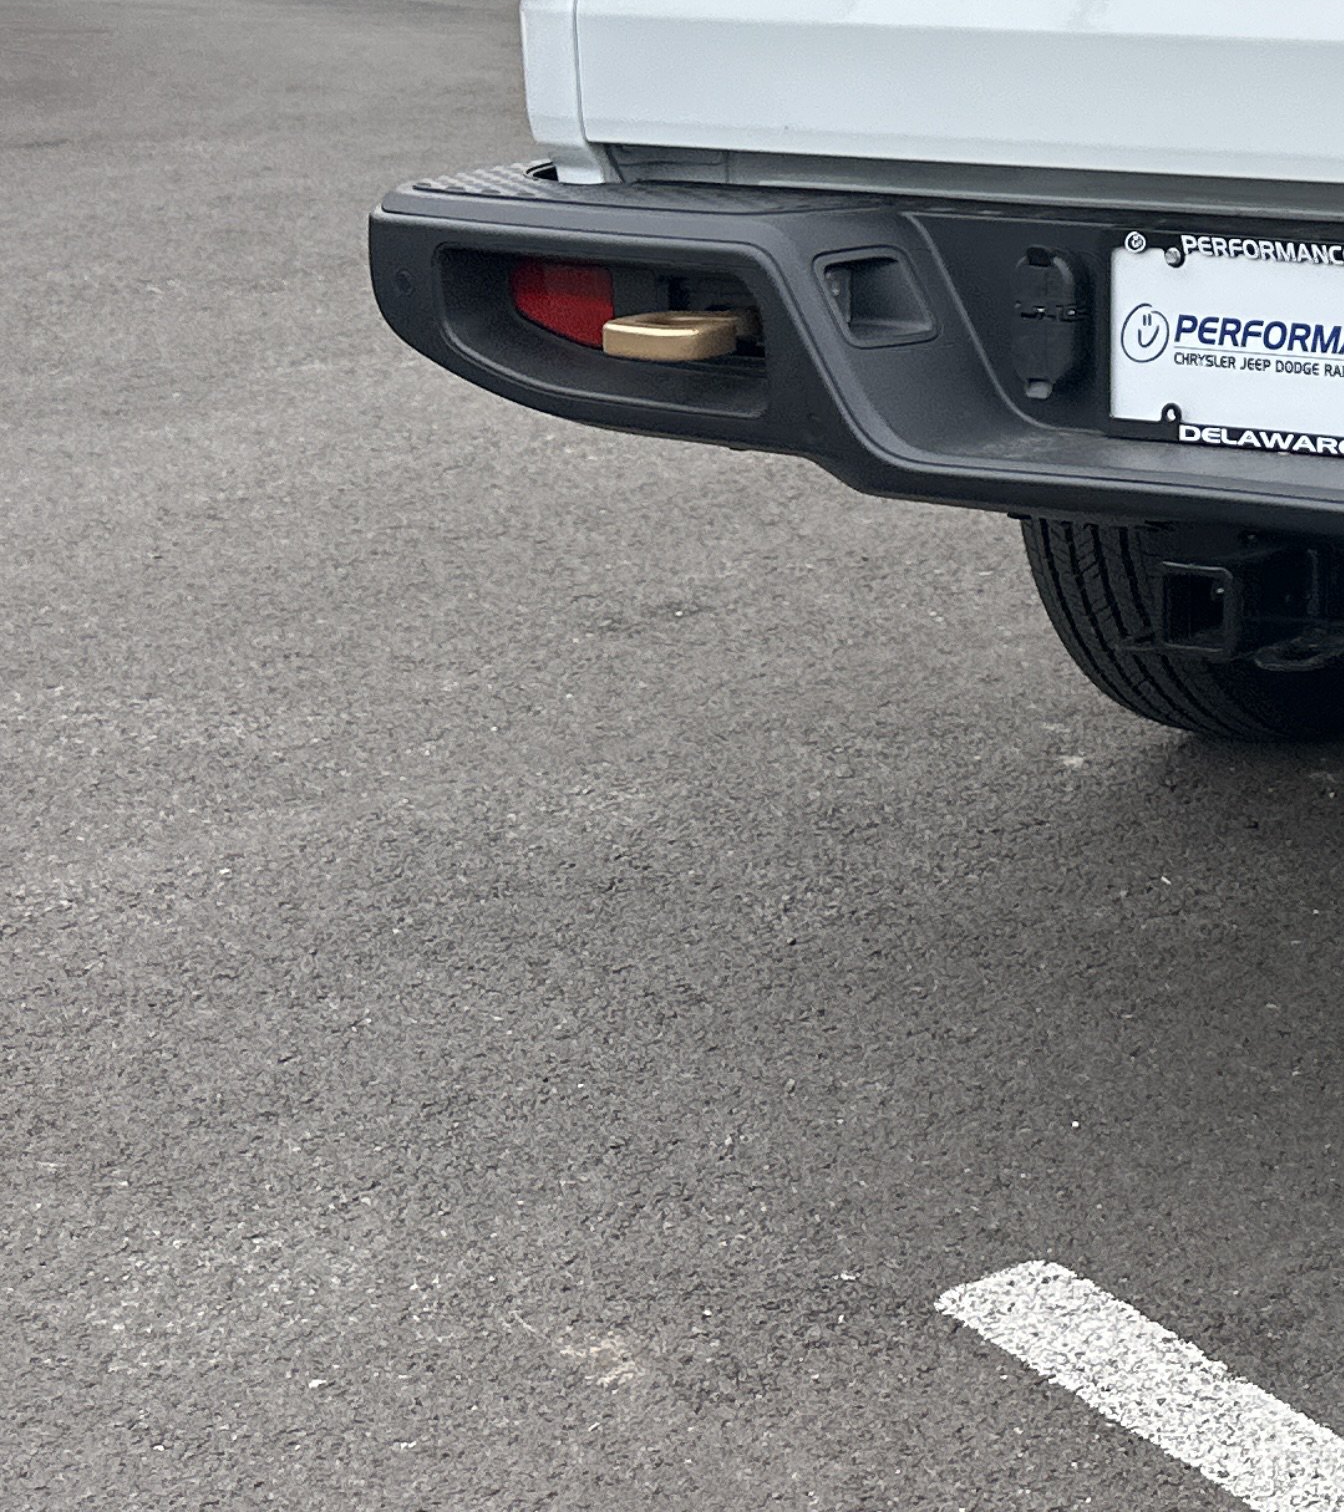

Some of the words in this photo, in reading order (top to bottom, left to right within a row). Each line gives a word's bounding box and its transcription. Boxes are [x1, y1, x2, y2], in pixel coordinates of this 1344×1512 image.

[1174, 352, 1236, 370] CHRYSLER
[1240, 357, 1271, 372] JEEP
[1275, 360, 1320, 376] DODGE
